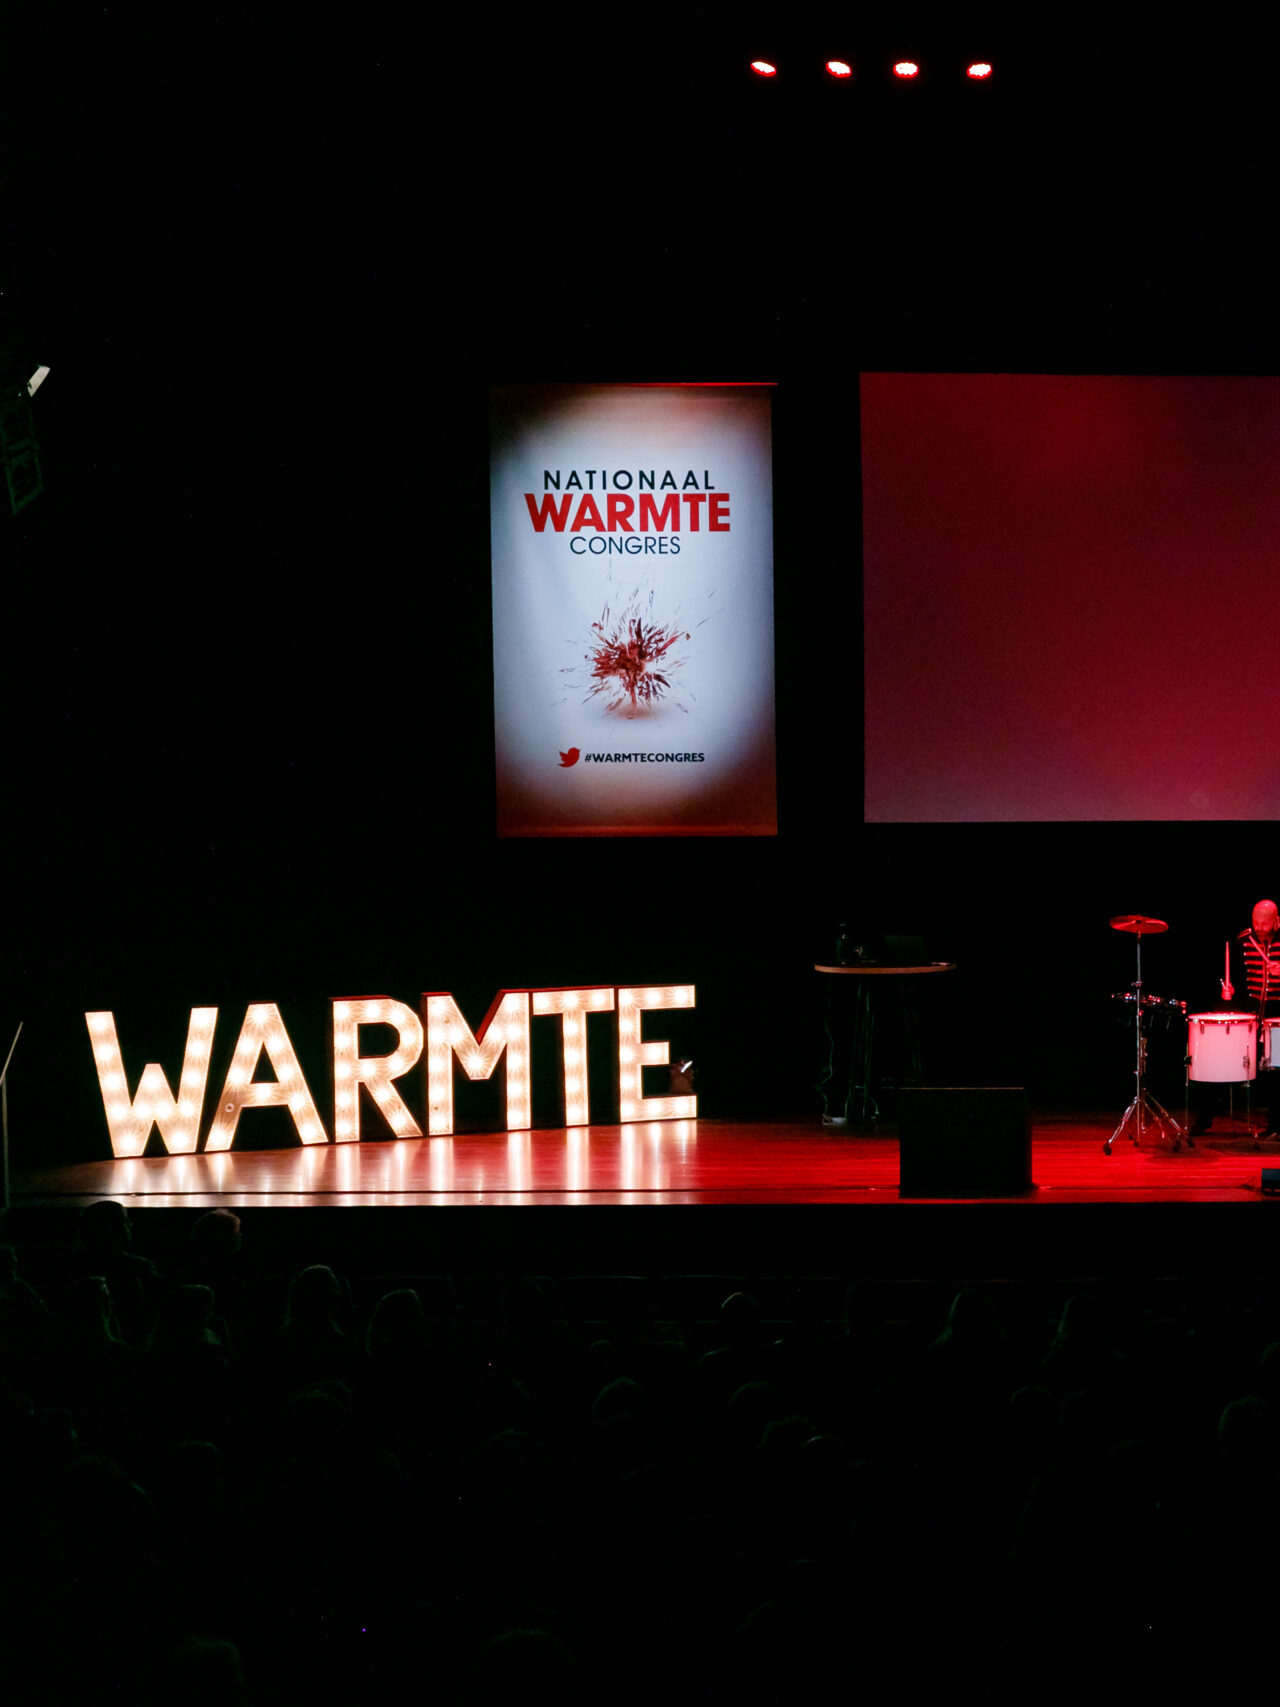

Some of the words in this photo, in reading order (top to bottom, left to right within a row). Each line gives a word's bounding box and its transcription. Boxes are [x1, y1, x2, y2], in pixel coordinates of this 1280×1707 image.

[543, 469, 716, 491] NATIONAAL
[524, 493, 731, 533] WARMTE
[569, 536, 681, 555] CONGRES
[584, 752, 705, 764] #WARMTECONGRES
[85, 984, 698, 1159] WARMTE
